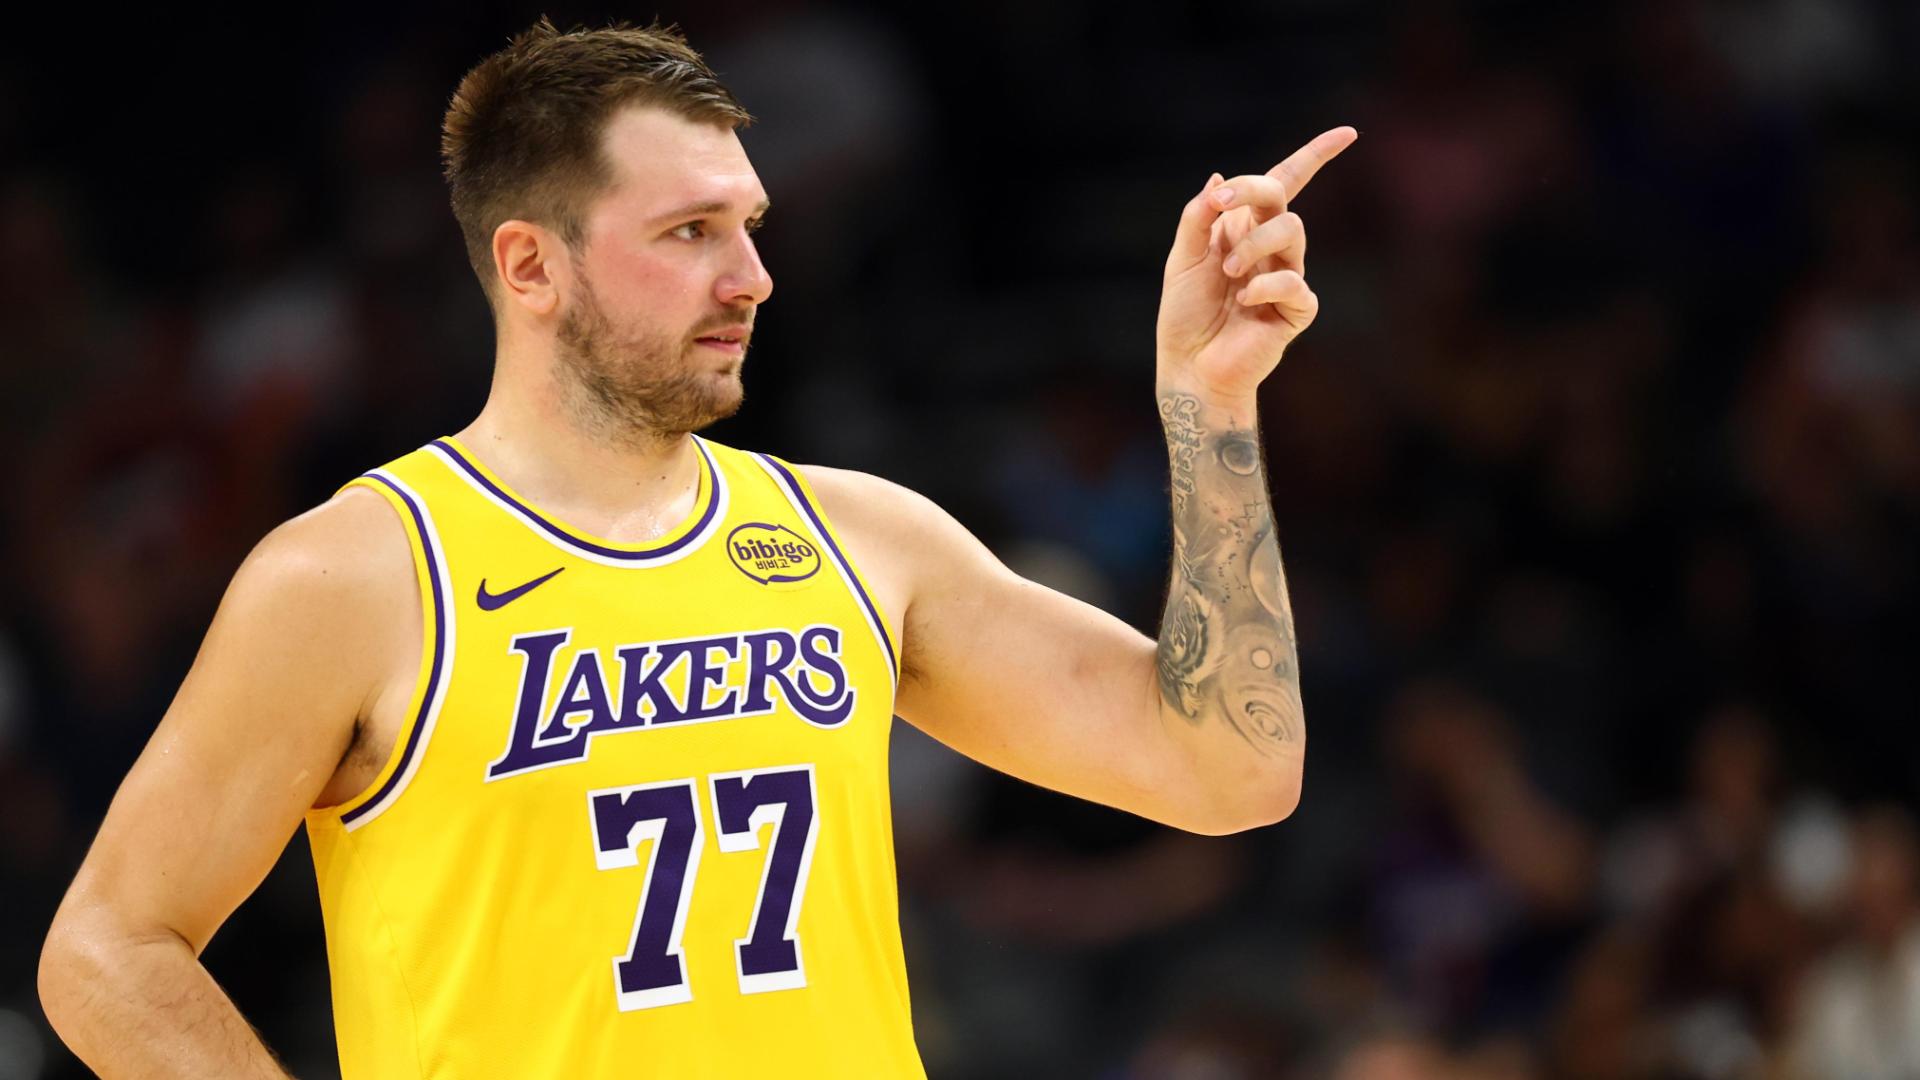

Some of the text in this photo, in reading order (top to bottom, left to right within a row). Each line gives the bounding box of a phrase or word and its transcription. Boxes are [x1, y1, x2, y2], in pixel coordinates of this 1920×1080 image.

[733, 538, 813, 563] bibigo
[485, 625, 856, 783] LAKERS
[588, 764, 820, 1012] 77
